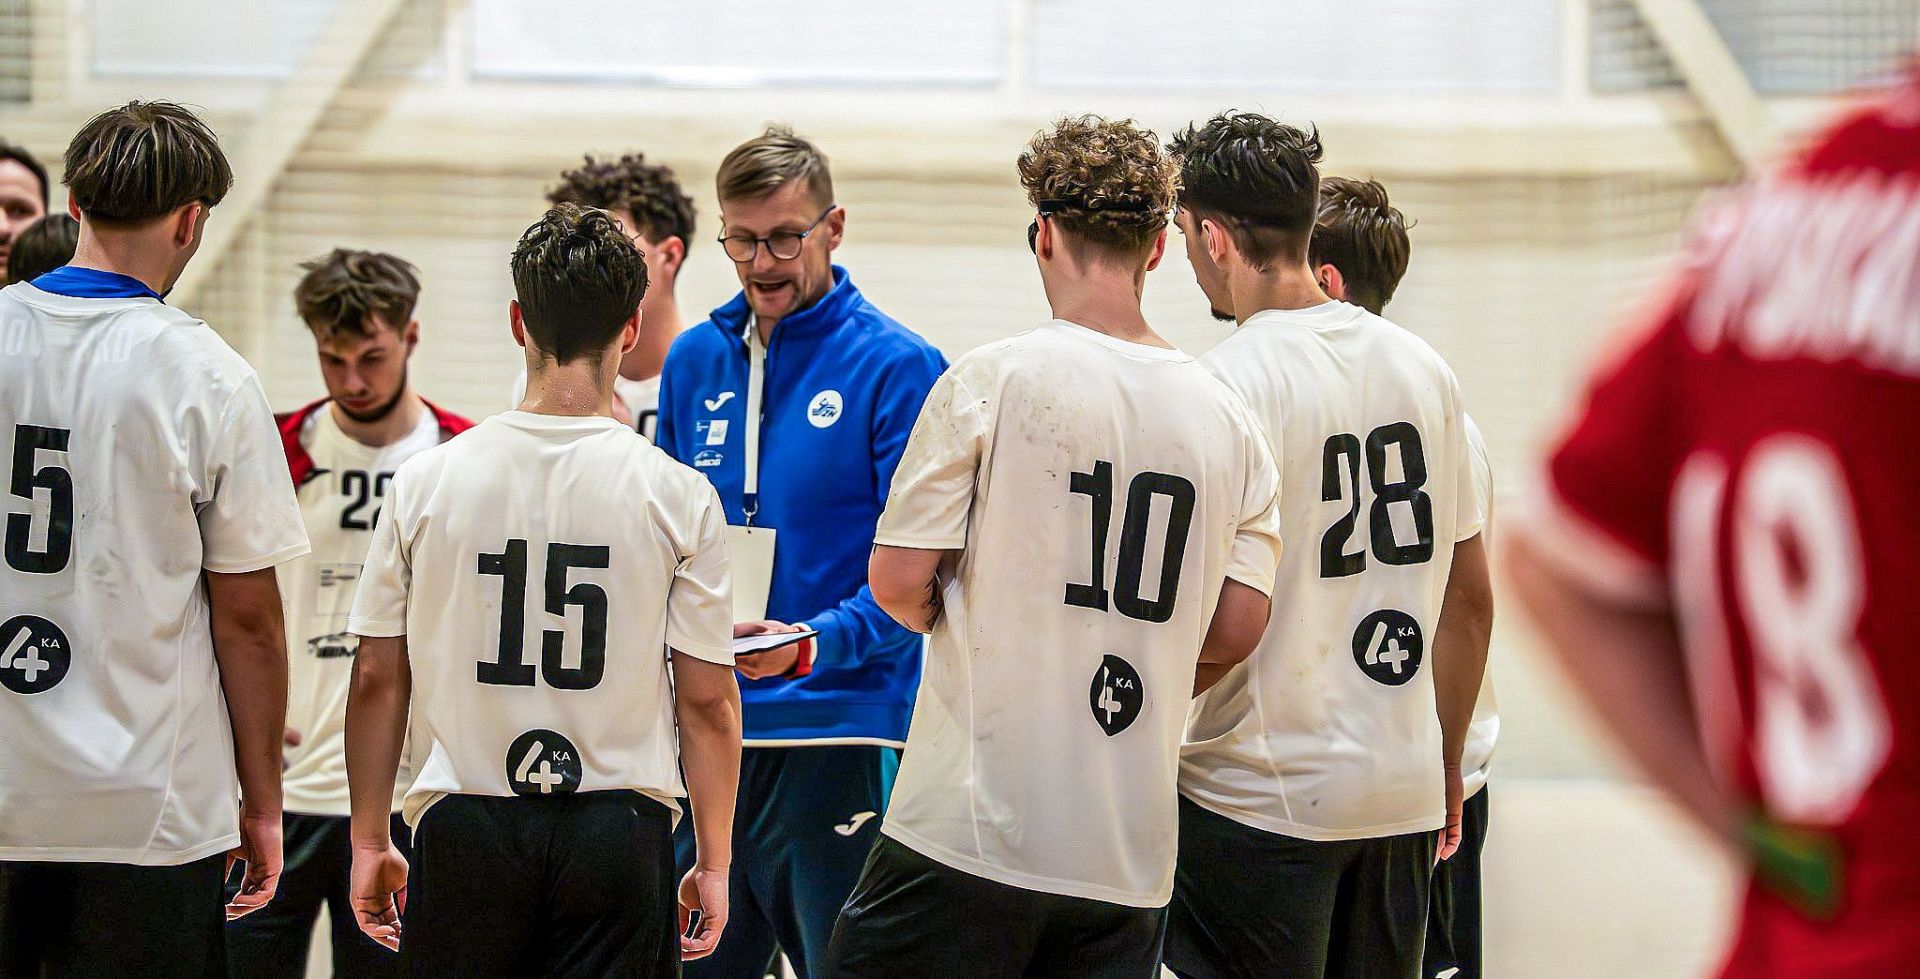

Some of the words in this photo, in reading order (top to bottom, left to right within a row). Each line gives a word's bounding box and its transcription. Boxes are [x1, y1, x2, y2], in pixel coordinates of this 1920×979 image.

[4, 424, 74, 574] 5
[1064, 460, 1196, 623] 10
[1320, 422, 1434, 579] 28
[476, 539, 610, 690] 15
